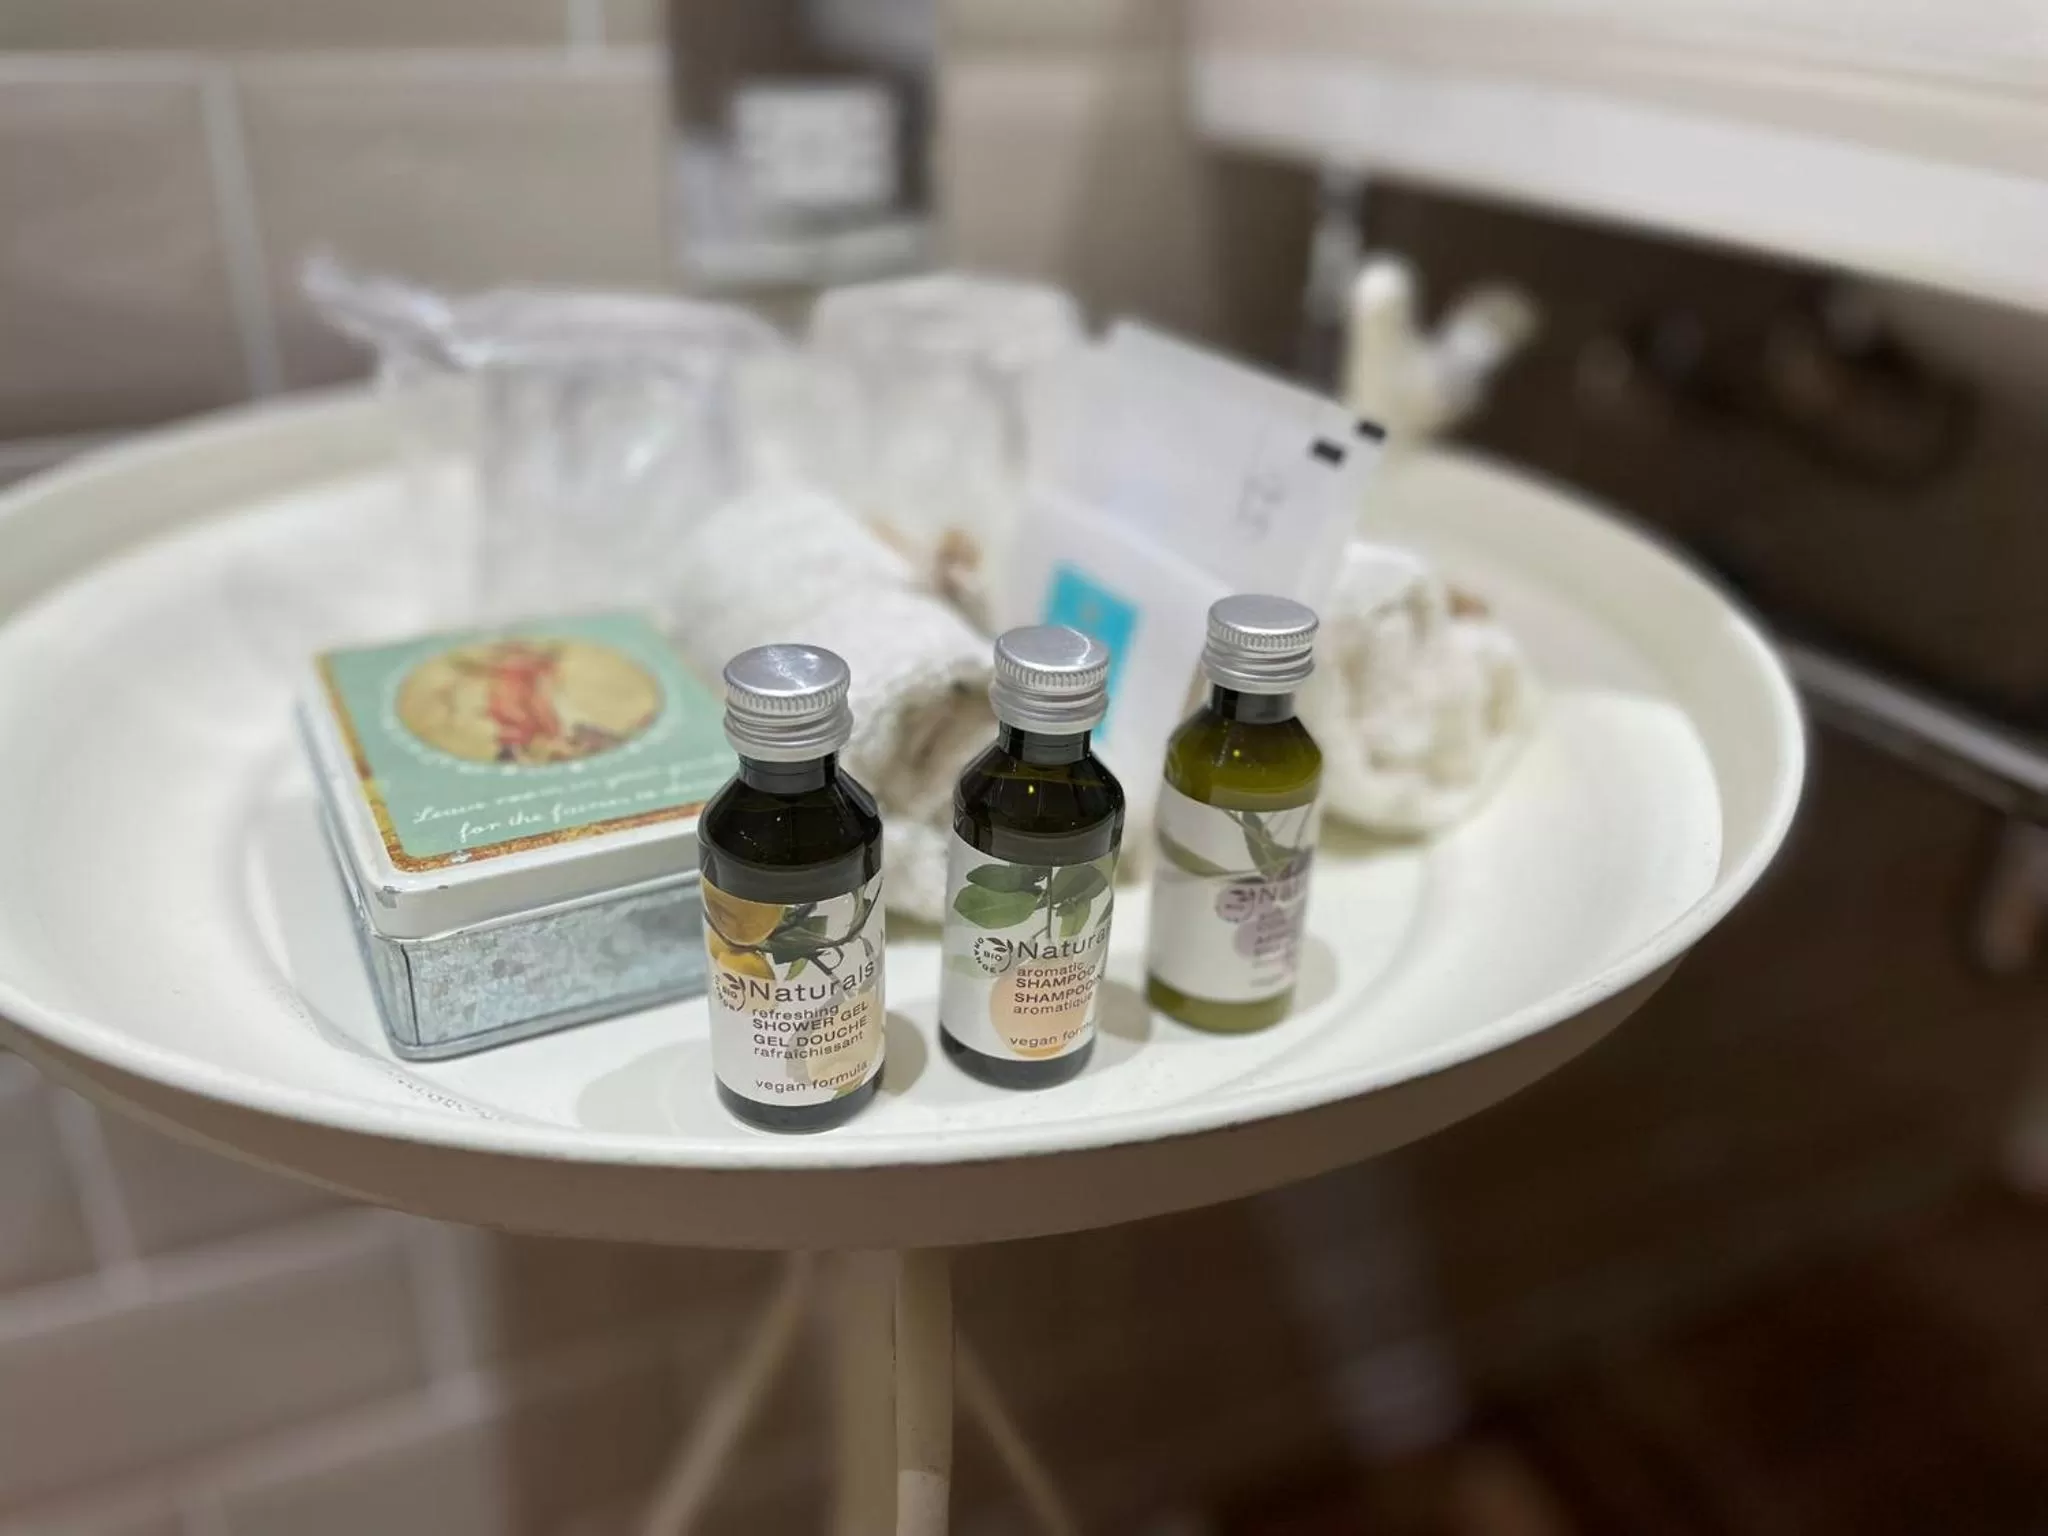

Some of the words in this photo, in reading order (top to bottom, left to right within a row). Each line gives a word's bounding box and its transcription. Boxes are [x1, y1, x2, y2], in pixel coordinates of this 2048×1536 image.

[459, 821, 501, 843] for
[1017, 926, 1109, 959] Natura
[750, 960, 874, 1002] Naturals
[1015, 964, 1096, 989] SHAMPOO
[1016, 962, 1084, 977] aromatic
[752, 1004, 840, 1020] refreshing
[753, 1016, 834, 1033] SHOWER
[840, 1000, 869, 1021] GEL
[753, 1034, 789, 1048] GEL
[796, 1015, 868, 1047] DOUCHE
[1009, 1034, 1058, 1048] vegan
[755, 1080, 806, 1094] vegan
[813, 1060, 868, 1089] formula
